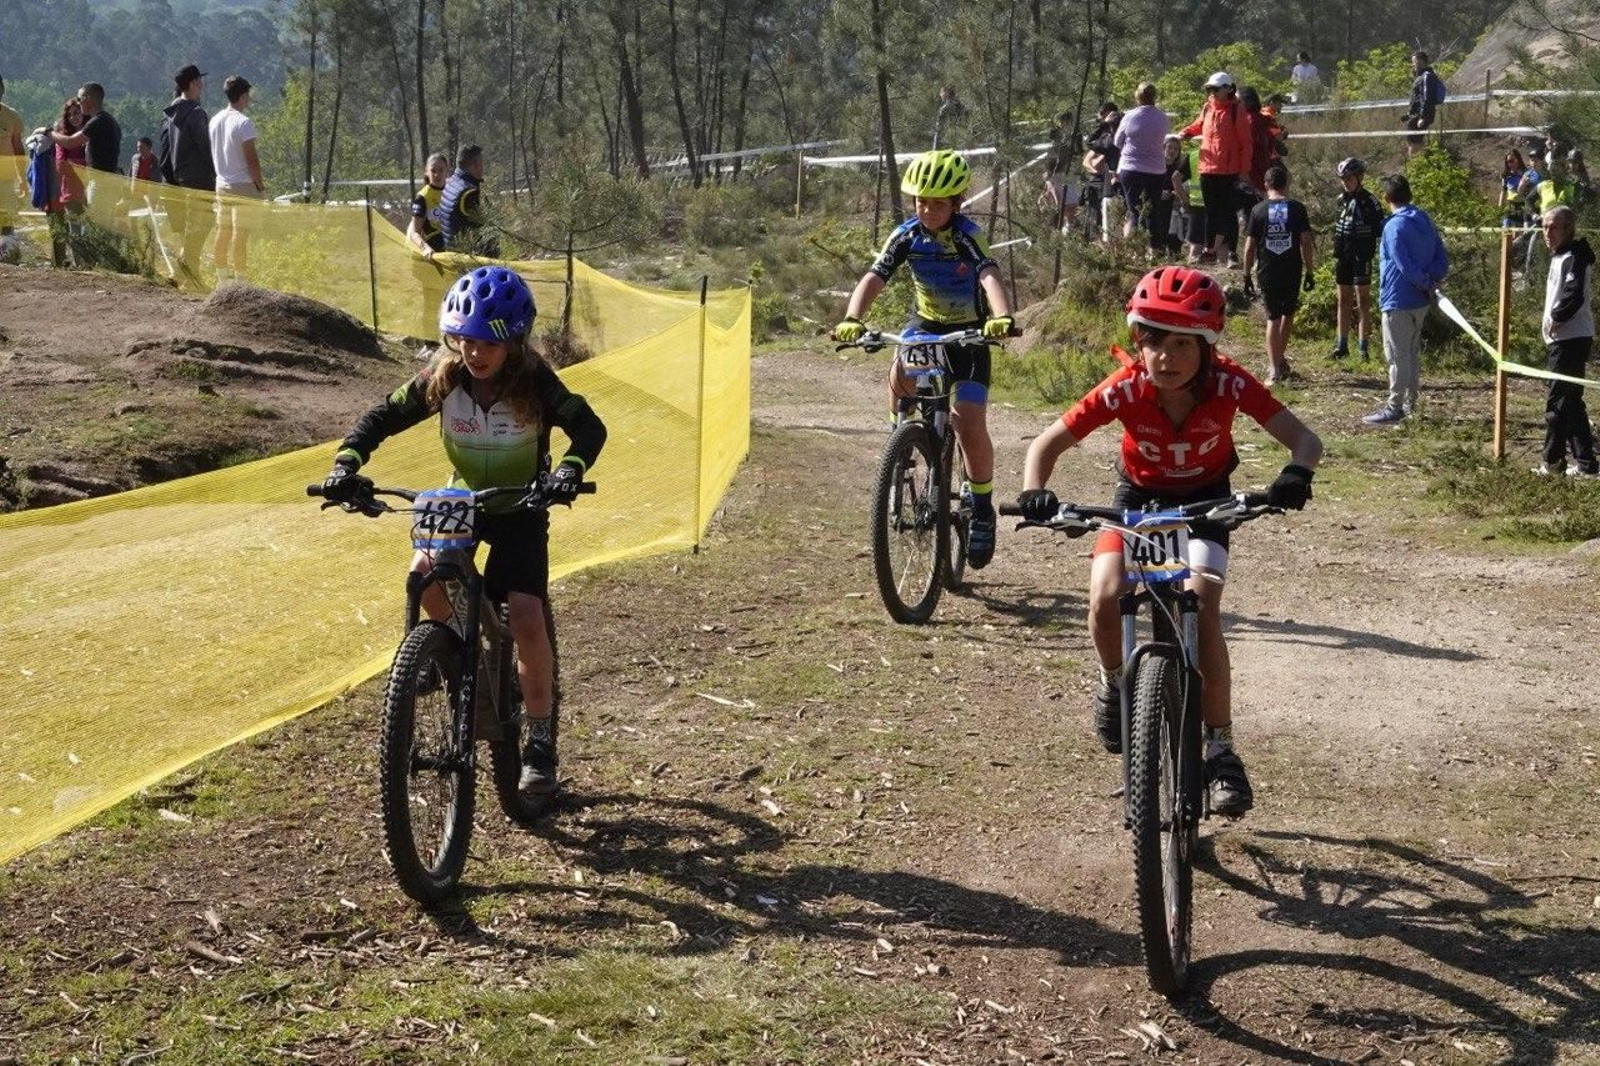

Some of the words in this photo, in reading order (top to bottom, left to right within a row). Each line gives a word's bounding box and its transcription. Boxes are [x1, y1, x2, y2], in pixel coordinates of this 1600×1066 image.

[907, 343, 937, 366] 431
[553, 482, 577, 492] FOX
[420, 501, 468, 533] 422
[1132, 530, 1180, 566] 401
[459, 674, 474, 740] MANITOU
